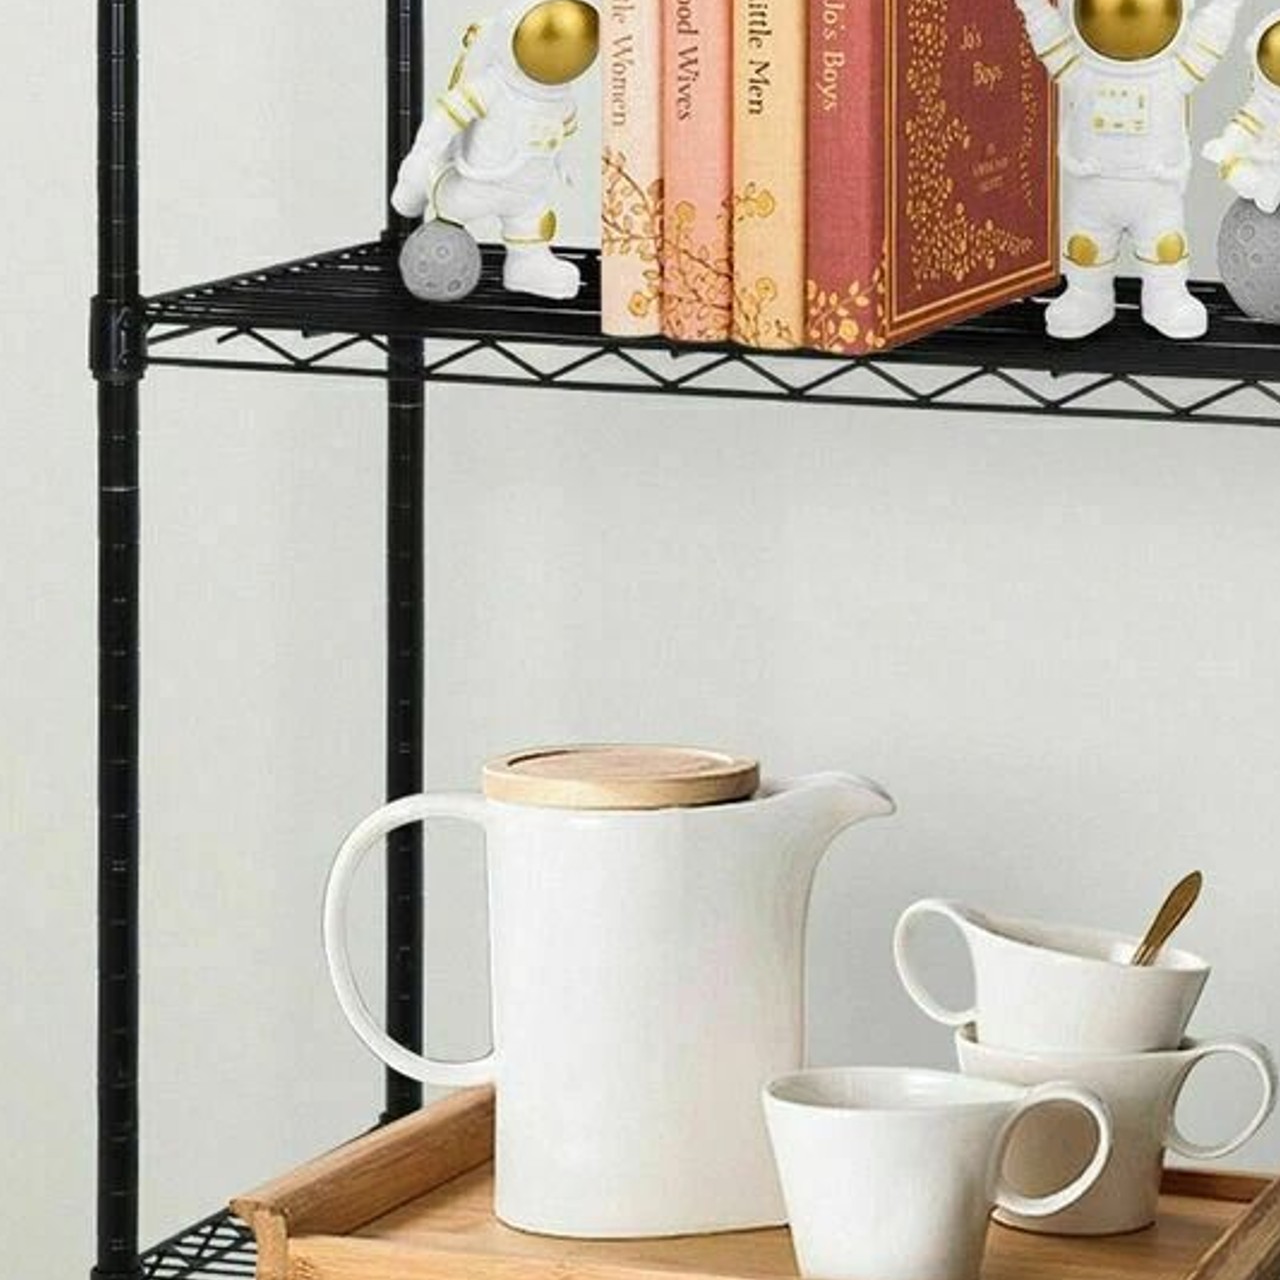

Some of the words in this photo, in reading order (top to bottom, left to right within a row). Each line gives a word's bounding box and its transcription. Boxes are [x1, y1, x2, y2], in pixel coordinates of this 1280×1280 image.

[612, 34, 634, 127] Women
[677, 45, 700, 121] Wives
[748, 60, 771, 115] Men
[816, 51, 845, 111] Boys
[973, 60, 1003, 91] Boys
